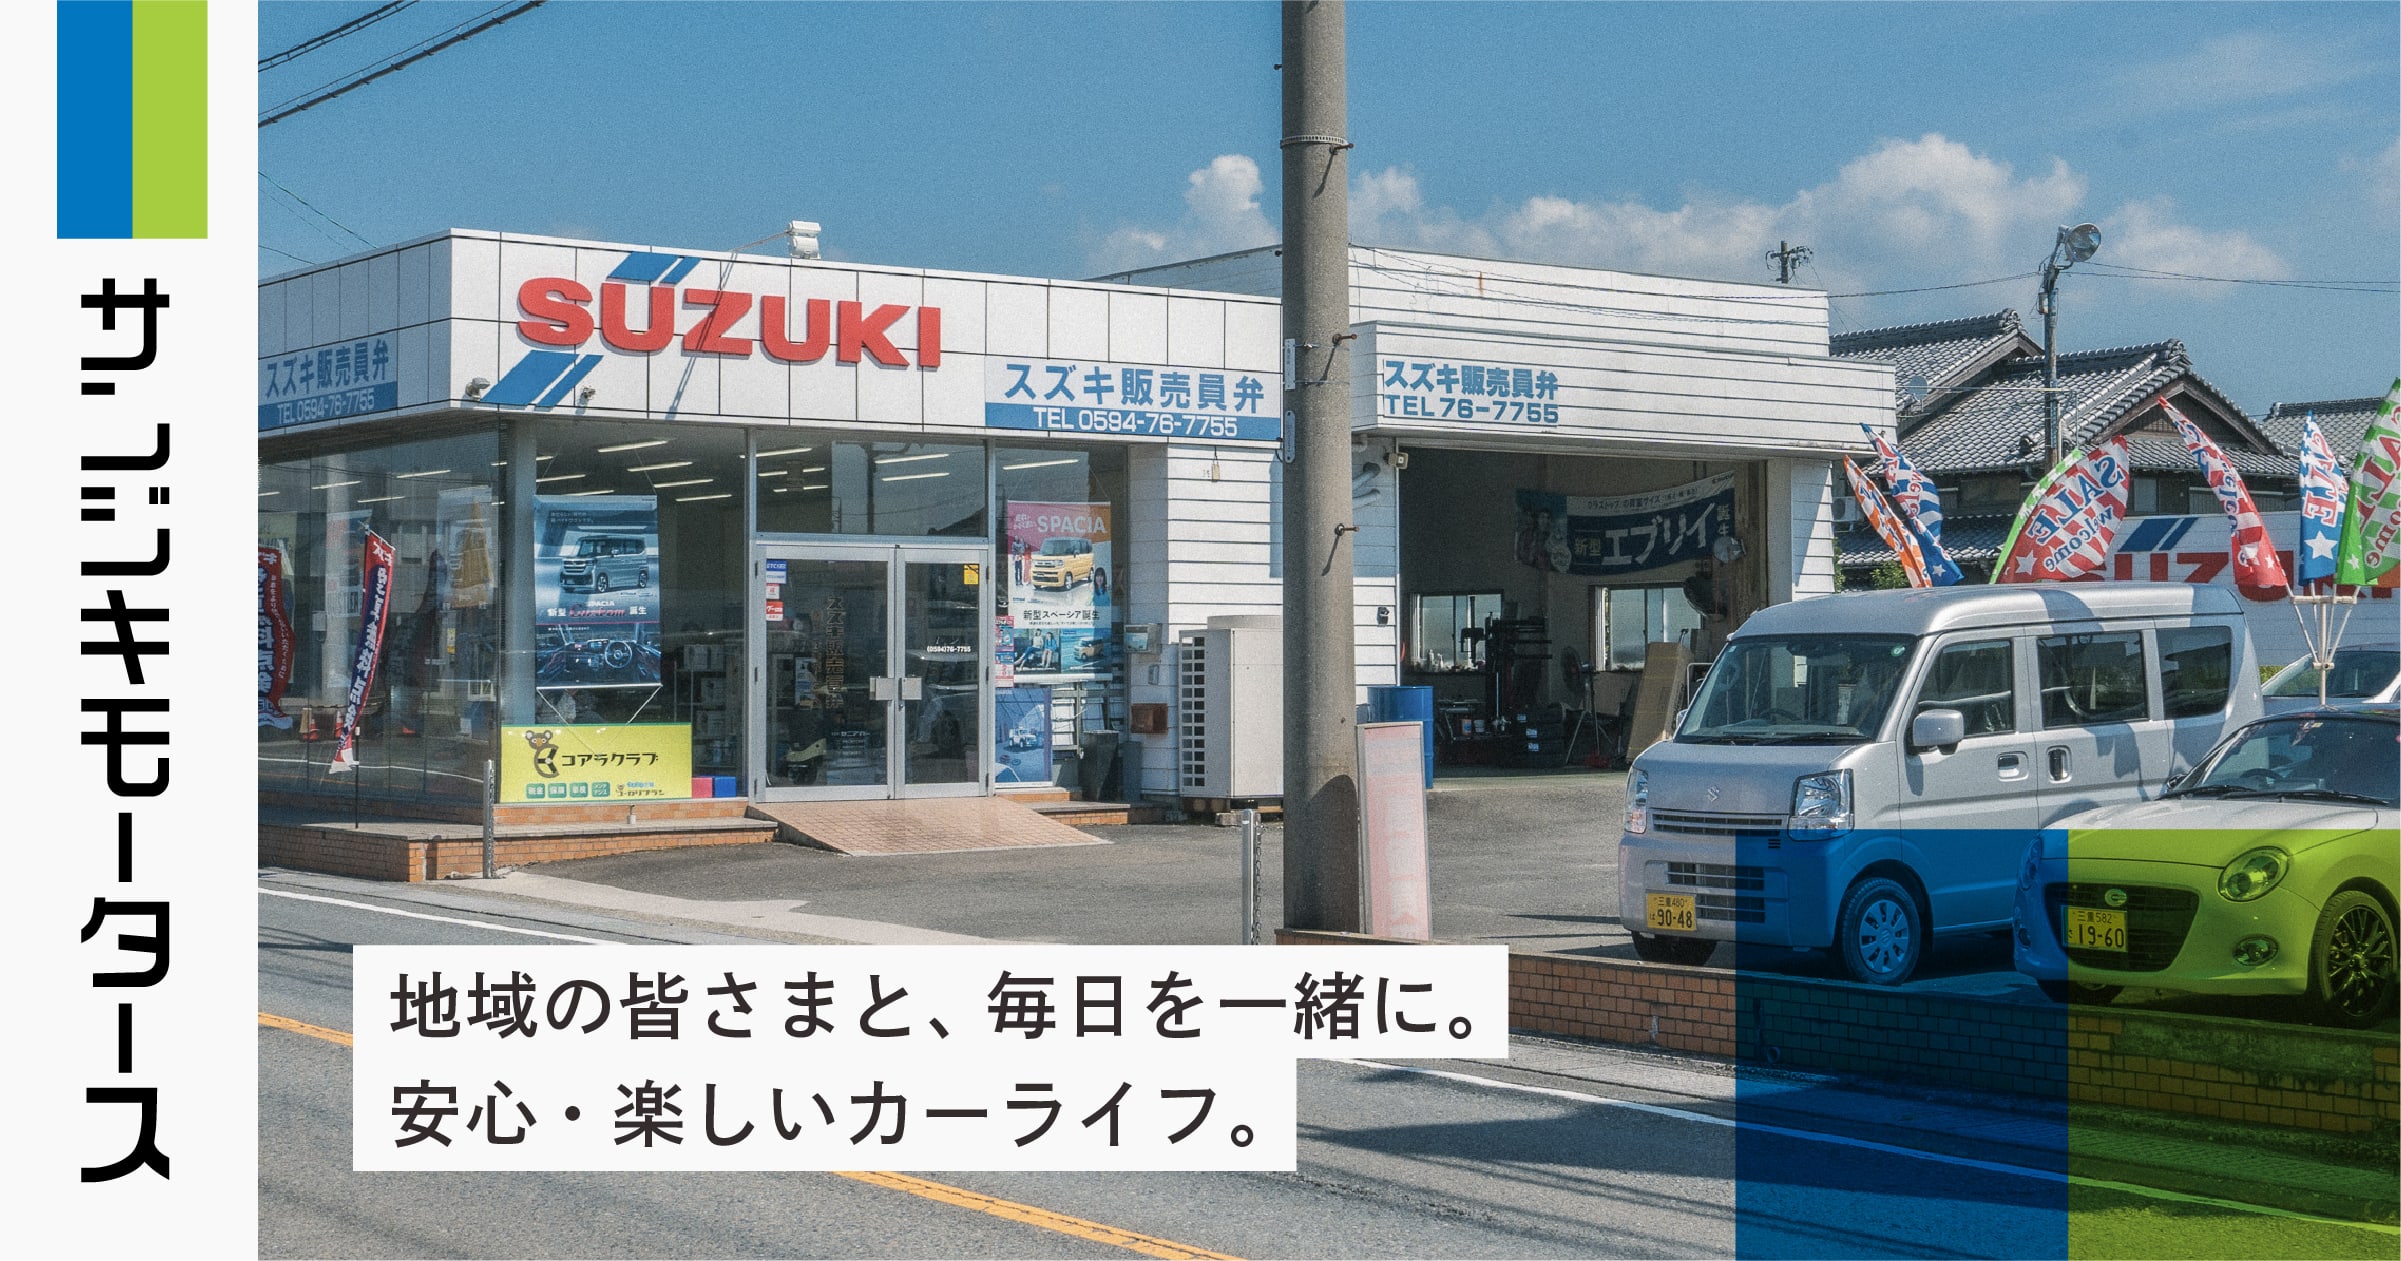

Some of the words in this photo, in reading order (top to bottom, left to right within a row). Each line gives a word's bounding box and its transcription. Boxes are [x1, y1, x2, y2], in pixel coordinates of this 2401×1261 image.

[517, 277, 941, 368] SUZUKI
[266, 338, 389, 399] スズキ販売員弁
[1385, 360, 1559, 400] スズキ販売員弁
[1004, 363, 1264, 414] スズキ販売員弁
[277, 402, 296, 425] TEL
[297, 387, 375, 422] 0594-76-7755
[1033, 406, 1075, 430] TEL
[1078, 410, 1238, 437] 0594-76-7755
[1385, 394, 1435, 417] TEL
[1439, 397, 1559, 424] 76-7755
[1037, 515, 1107, 534] SPACIA
[1601, 503, 1715, 566] エブリイ
[562, 752, 659, 767] コアラクラブ
[1657, 909, 1693, 929] 90-48
[2079, 923, 2125, 948] 19-60
